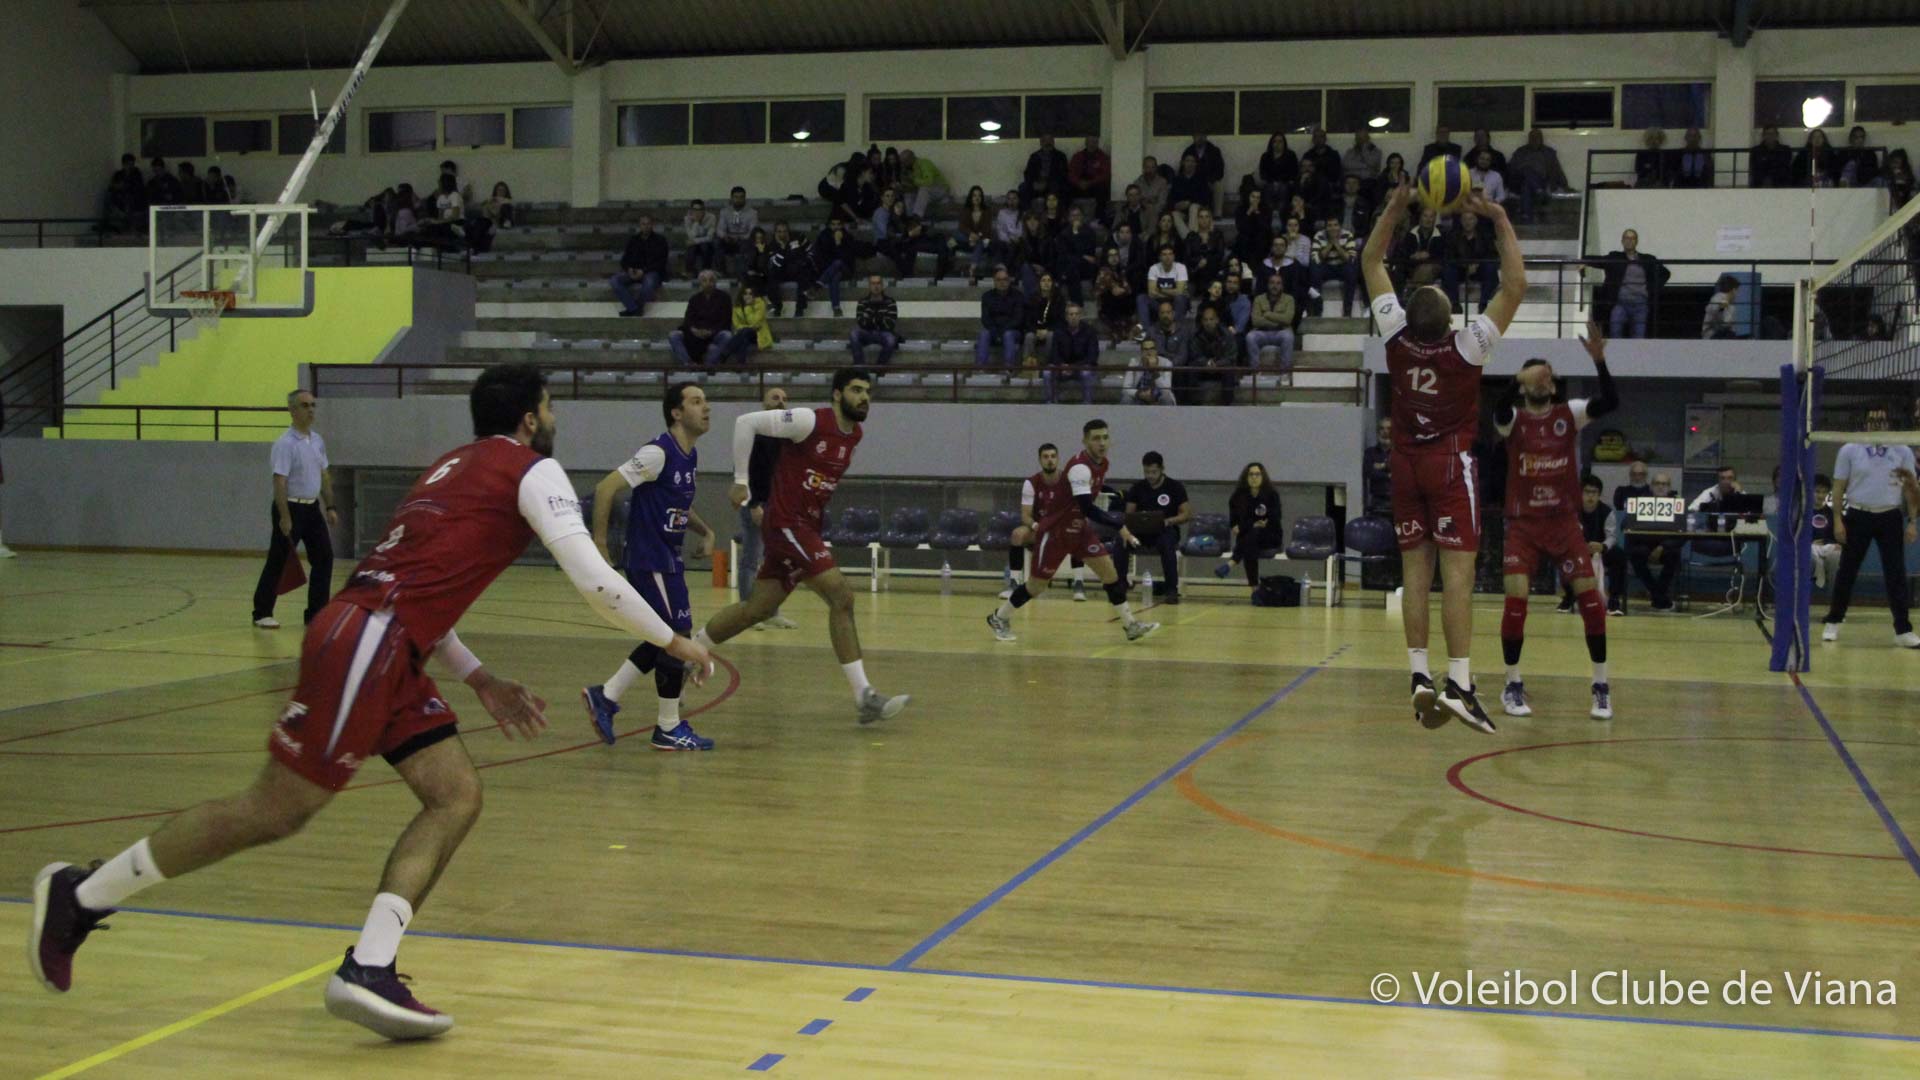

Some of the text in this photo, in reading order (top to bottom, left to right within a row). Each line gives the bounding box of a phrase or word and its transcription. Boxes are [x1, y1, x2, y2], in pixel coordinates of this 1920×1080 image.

[1406, 366, 1439, 395] 12
[425, 457, 461, 485] 6
[1628, 501, 1683, 517] 1 23 23 0
